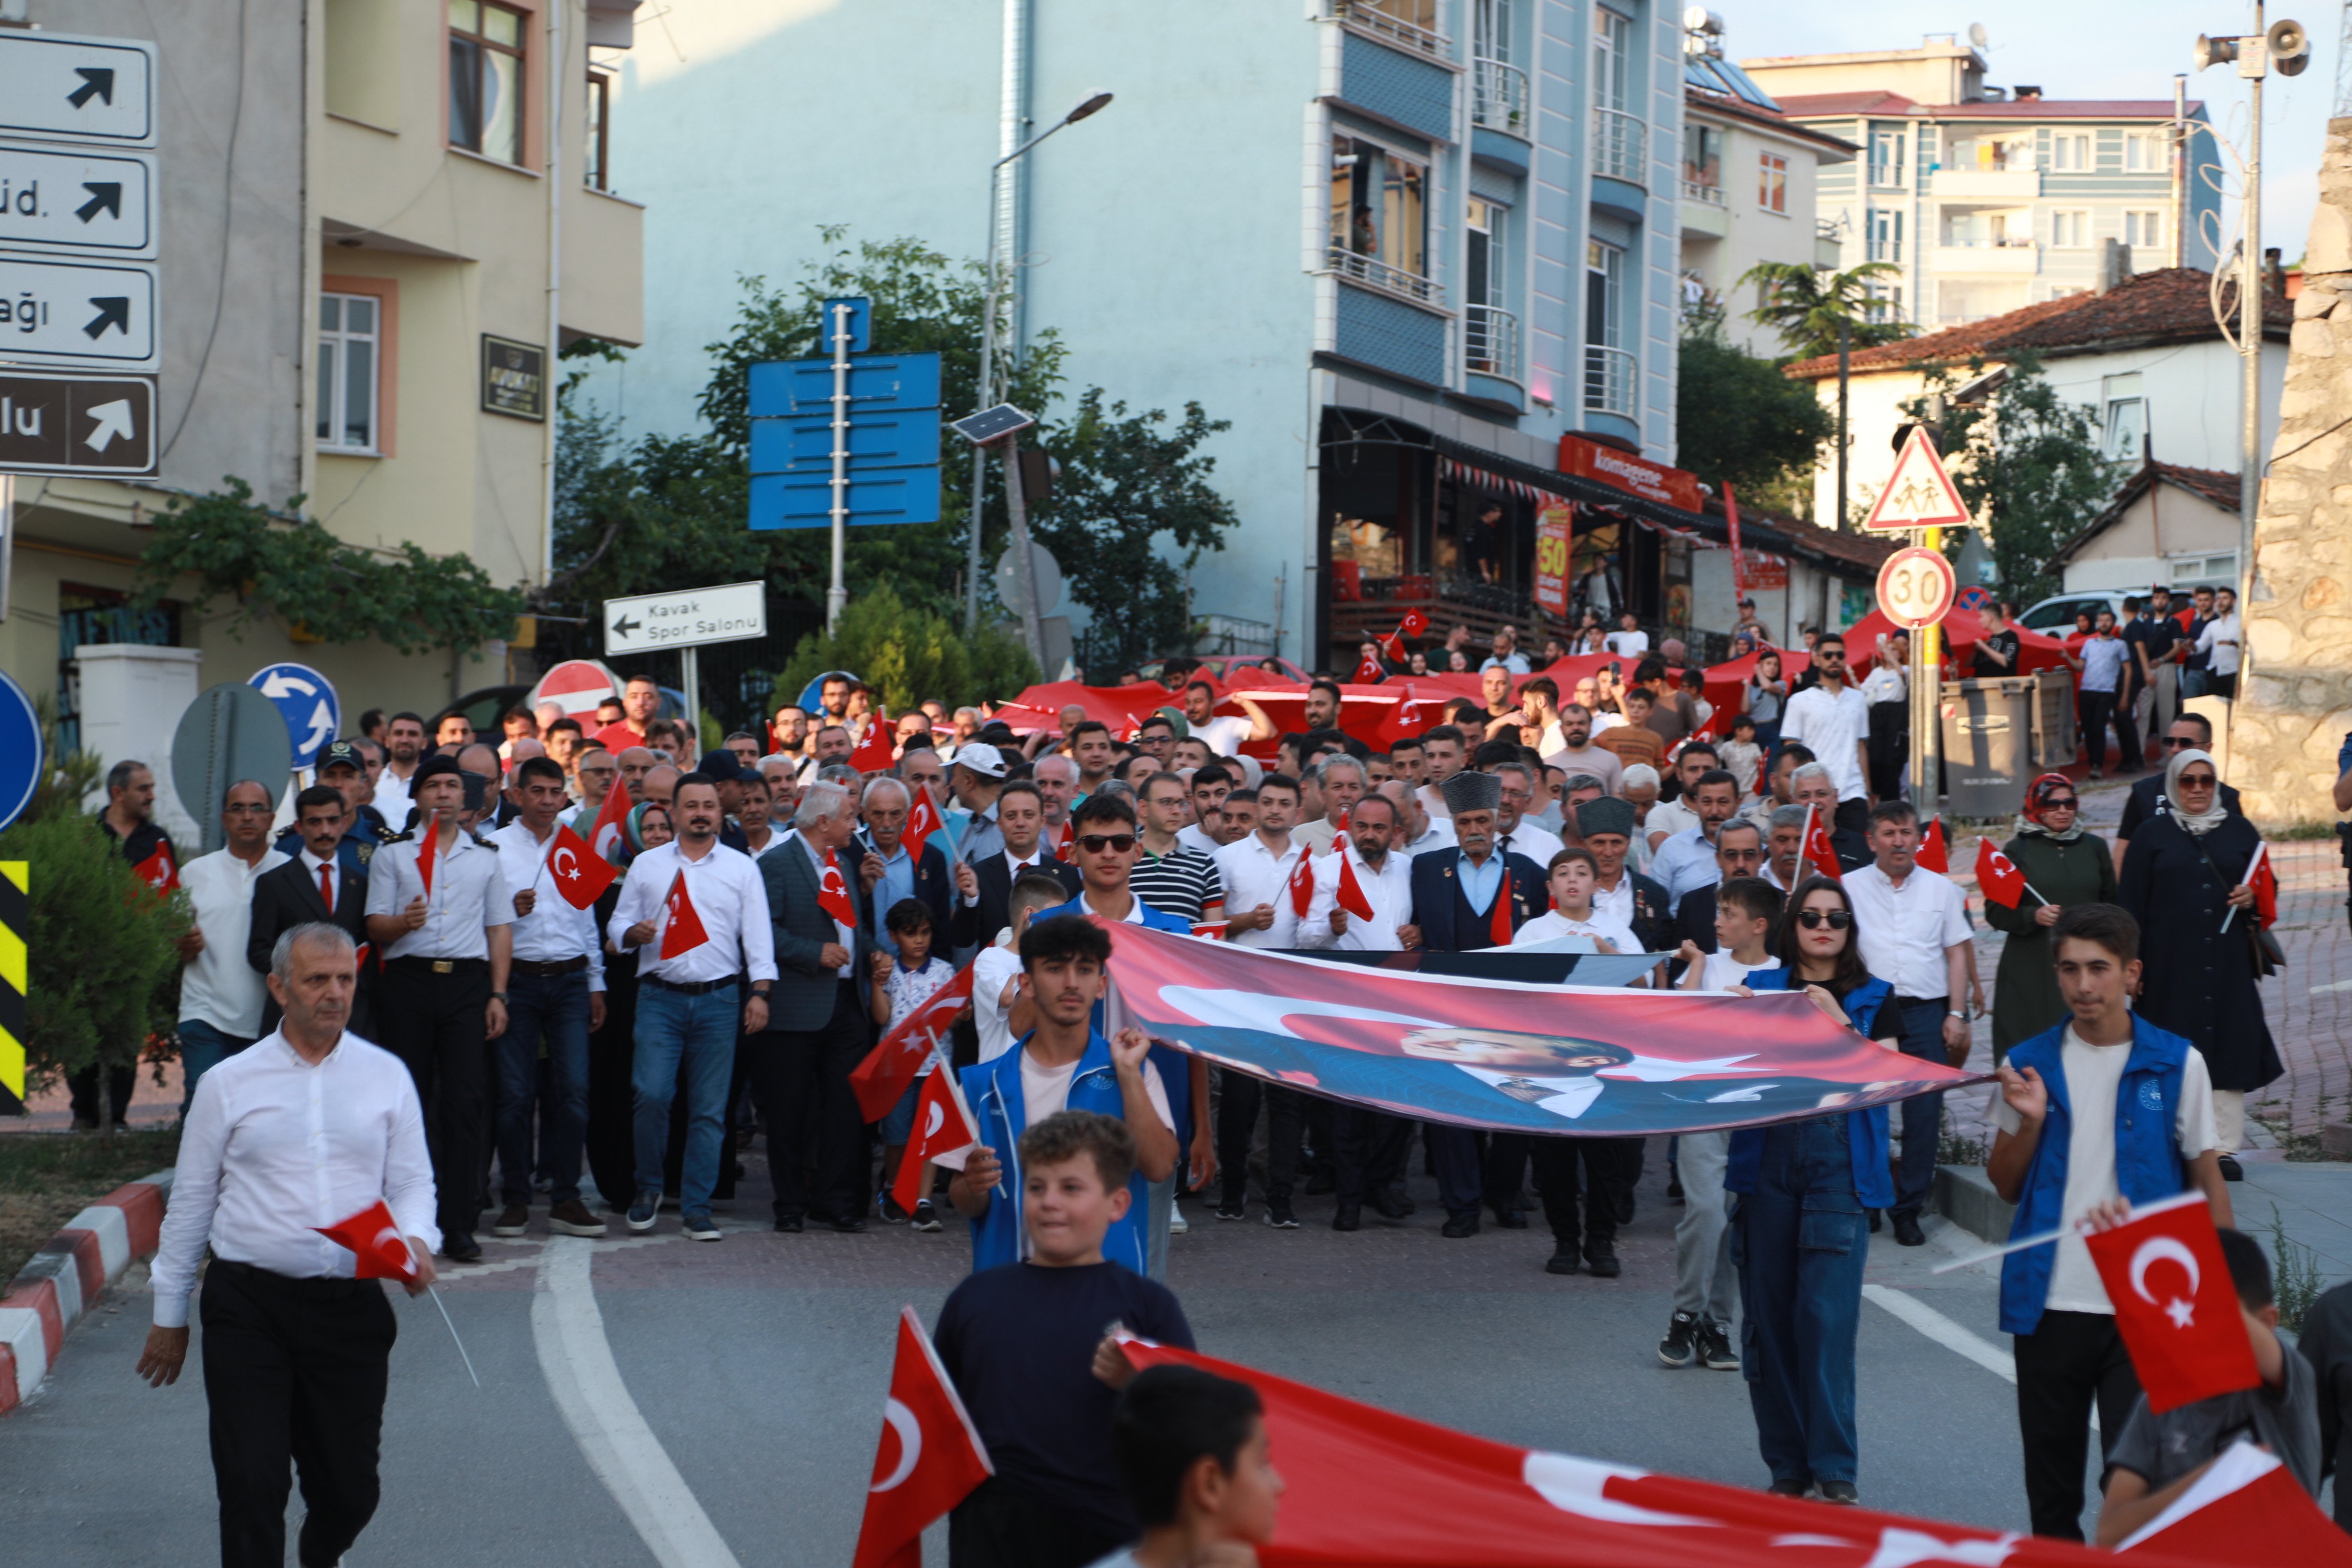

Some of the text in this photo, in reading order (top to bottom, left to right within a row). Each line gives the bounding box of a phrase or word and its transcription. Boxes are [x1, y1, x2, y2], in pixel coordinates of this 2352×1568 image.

[1594, 447, 1663, 487] komagene
[1894, 569, 1939, 605] 30
[648, 601, 700, 618] Kavak
[649, 618, 758, 641] Spor Salonu
